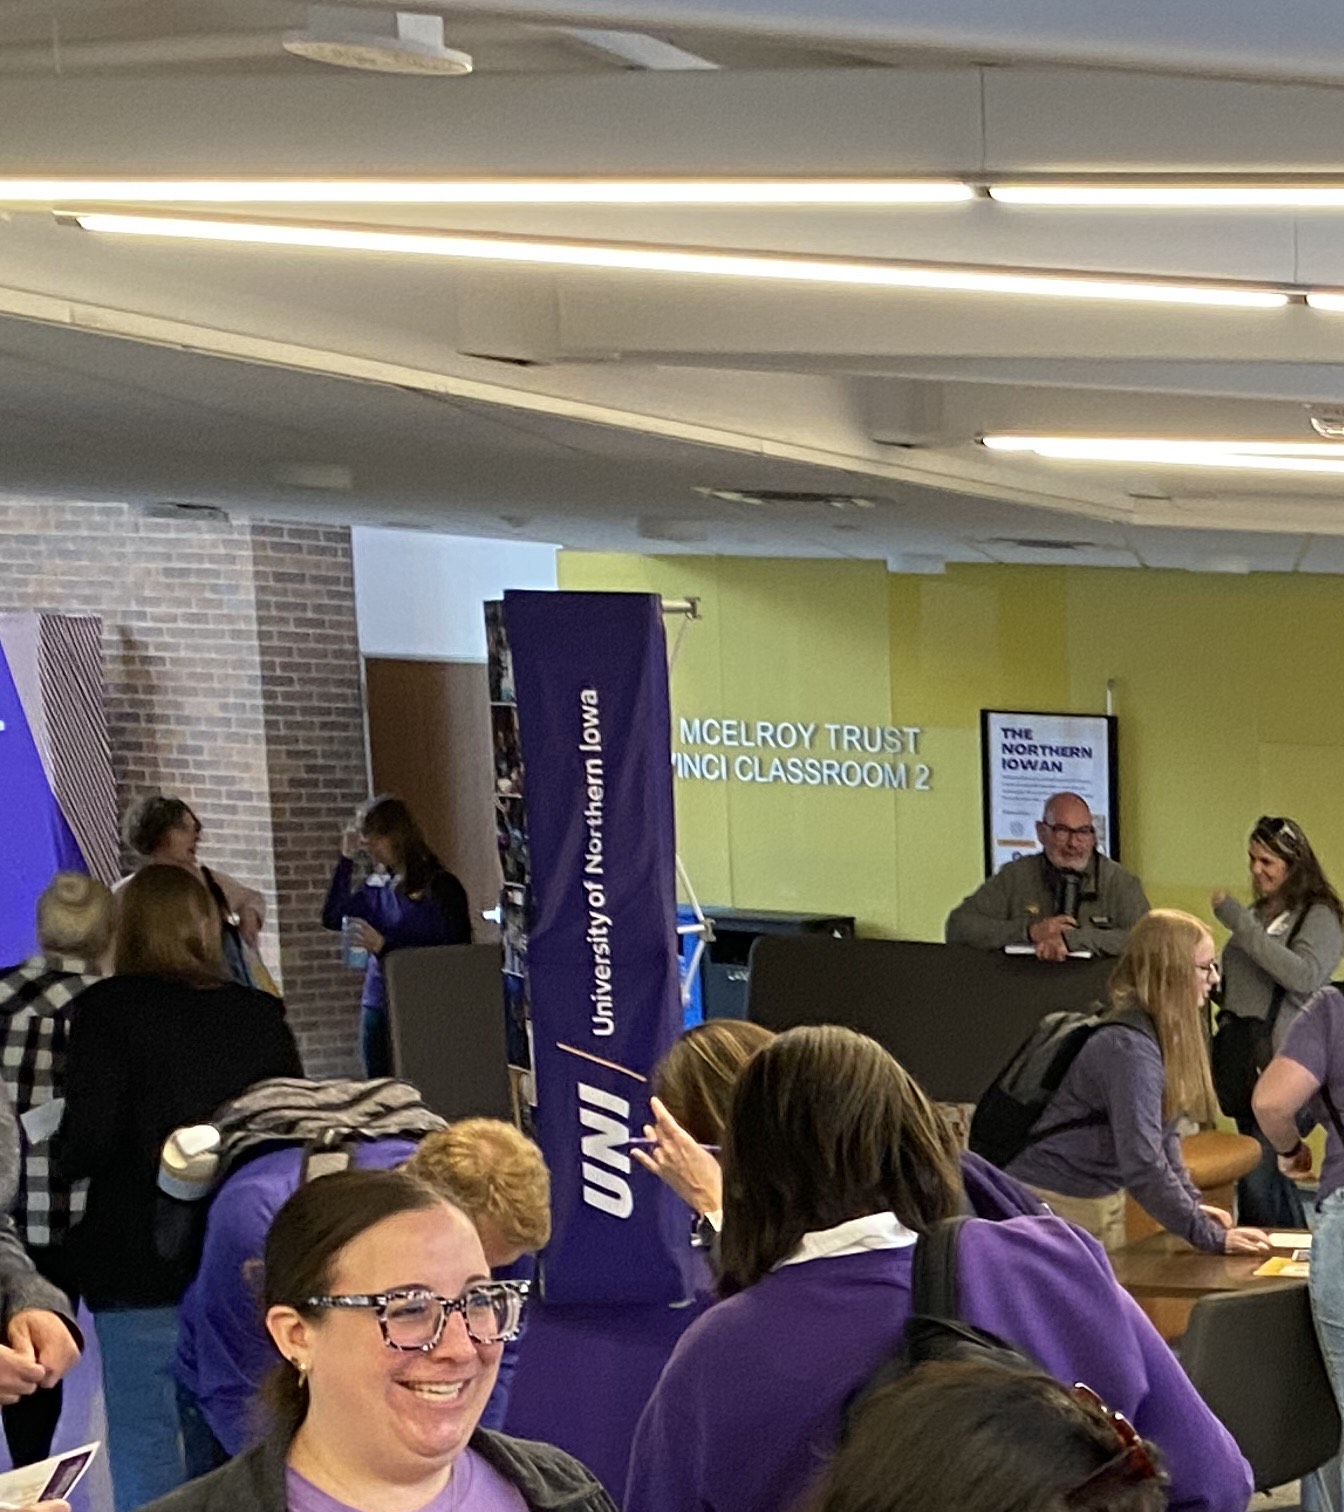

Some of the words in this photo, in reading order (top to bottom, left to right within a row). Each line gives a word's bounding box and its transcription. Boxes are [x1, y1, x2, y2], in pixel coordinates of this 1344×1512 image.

[579, 689, 599, 751] Iowa
[680, 717, 815, 751] MCELROY
[825, 723, 920, 754] TRUST
[1001, 727, 1033, 740] THE
[1001, 743, 1093, 759] NORTHERN
[1002, 758, 1063, 773] IOWAN
[672, 752, 727, 781] INCI
[734, 756, 907, 789] CLASSROOM
[914, 765, 931, 791] 2
[583, 757, 605, 874] Northern
[583, 880, 606, 908] of
[587, 912, 614, 1036] University
[577, 1081, 634, 1219] UNI
